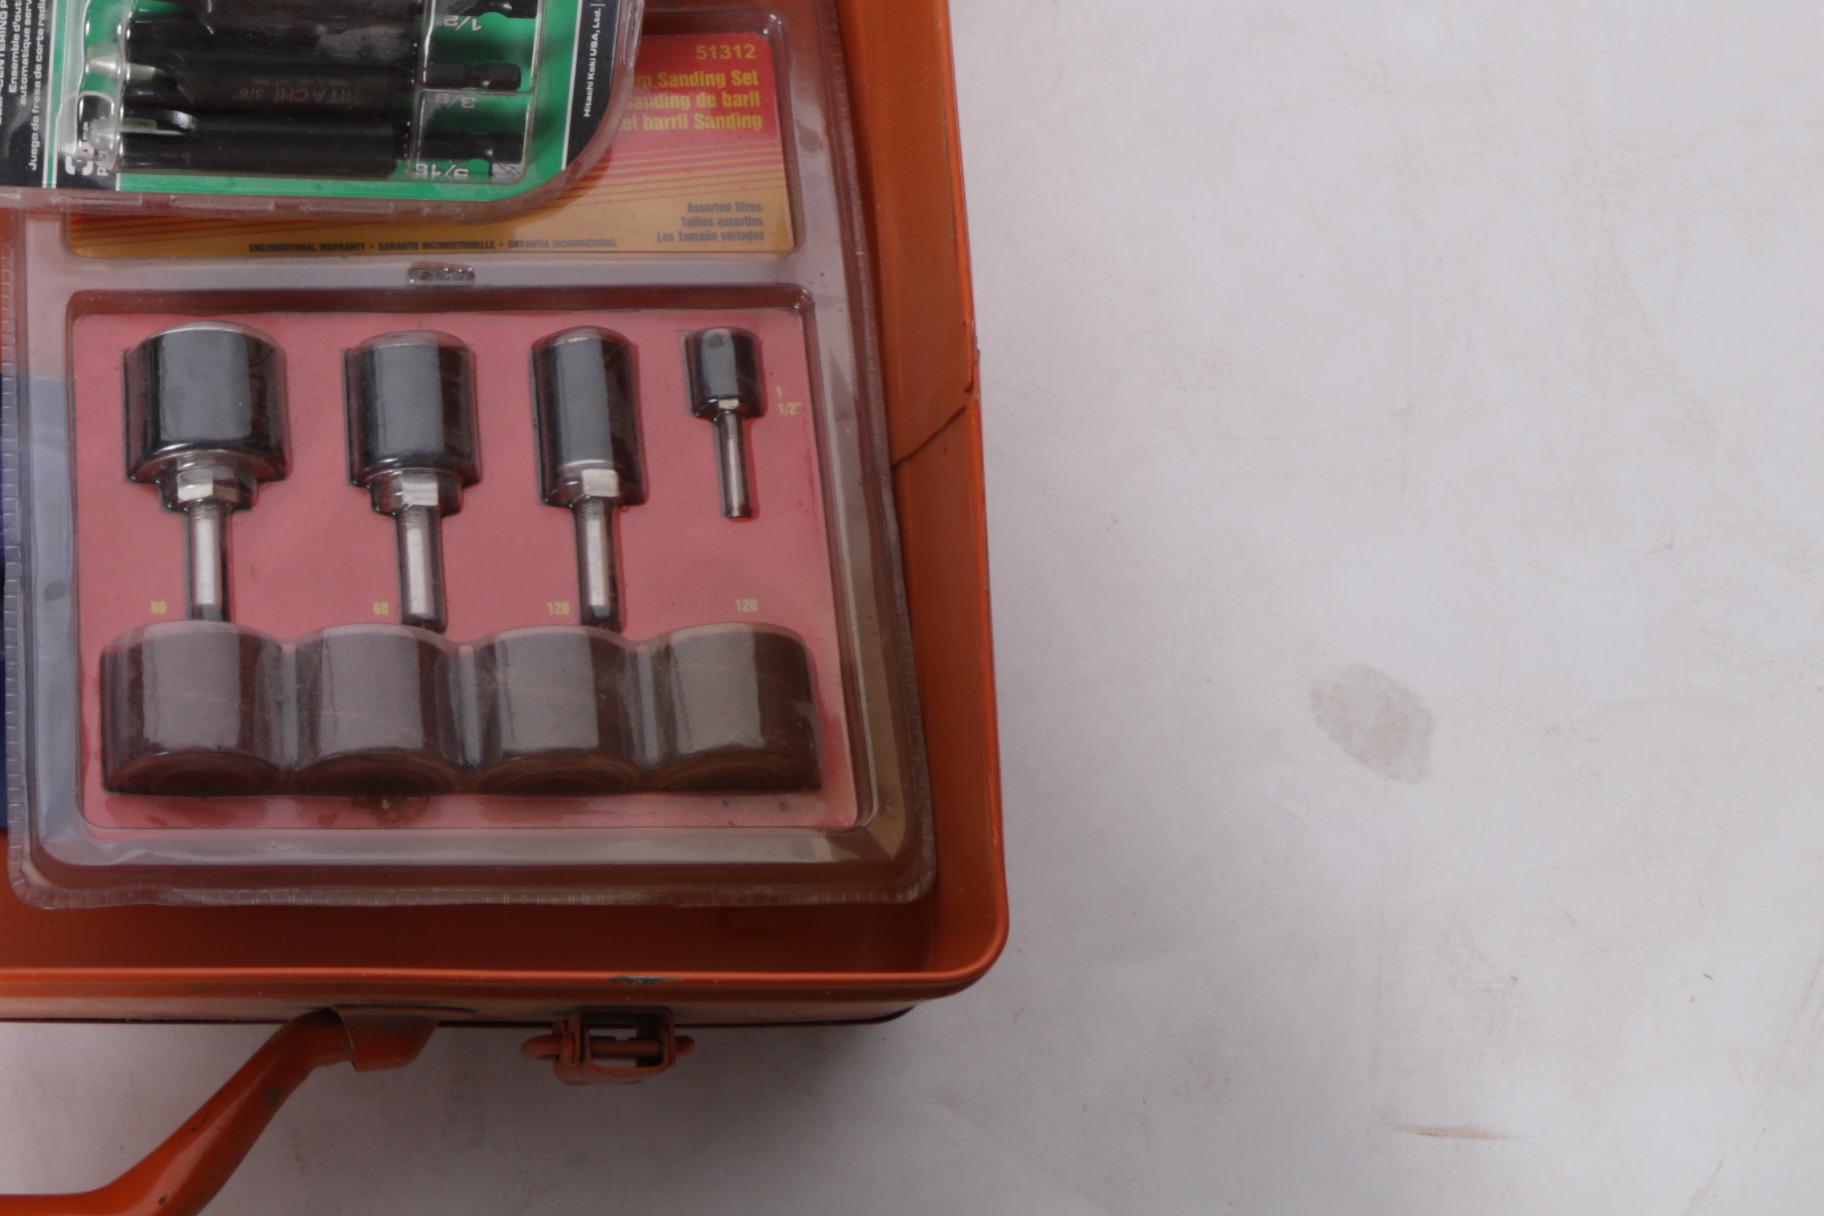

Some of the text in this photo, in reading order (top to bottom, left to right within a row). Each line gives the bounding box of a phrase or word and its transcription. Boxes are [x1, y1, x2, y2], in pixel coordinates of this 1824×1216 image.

[592, 8, 602, 29] Ltd.
[36, 28, 45, 62] corte
[589, 28, 601, 57] USA,
[696, 44, 757, 60] 51312
[9, 35, 20, 93] Ensemble
[20, 26, 33, 106] automatique
[33, 64, 42, 80] de
[587, 57, 597, 80] Koki
[658, 70, 759, 88] Sanding Set
[31, 81, 42, 114] fresa
[584, 81, 595, 117] Hitachi
[696, 92, 717, 107] de
[32, 116, 40, 131] de
[642, 113, 763, 131] barril Sanding
[28, 134, 41, 171] Juego
